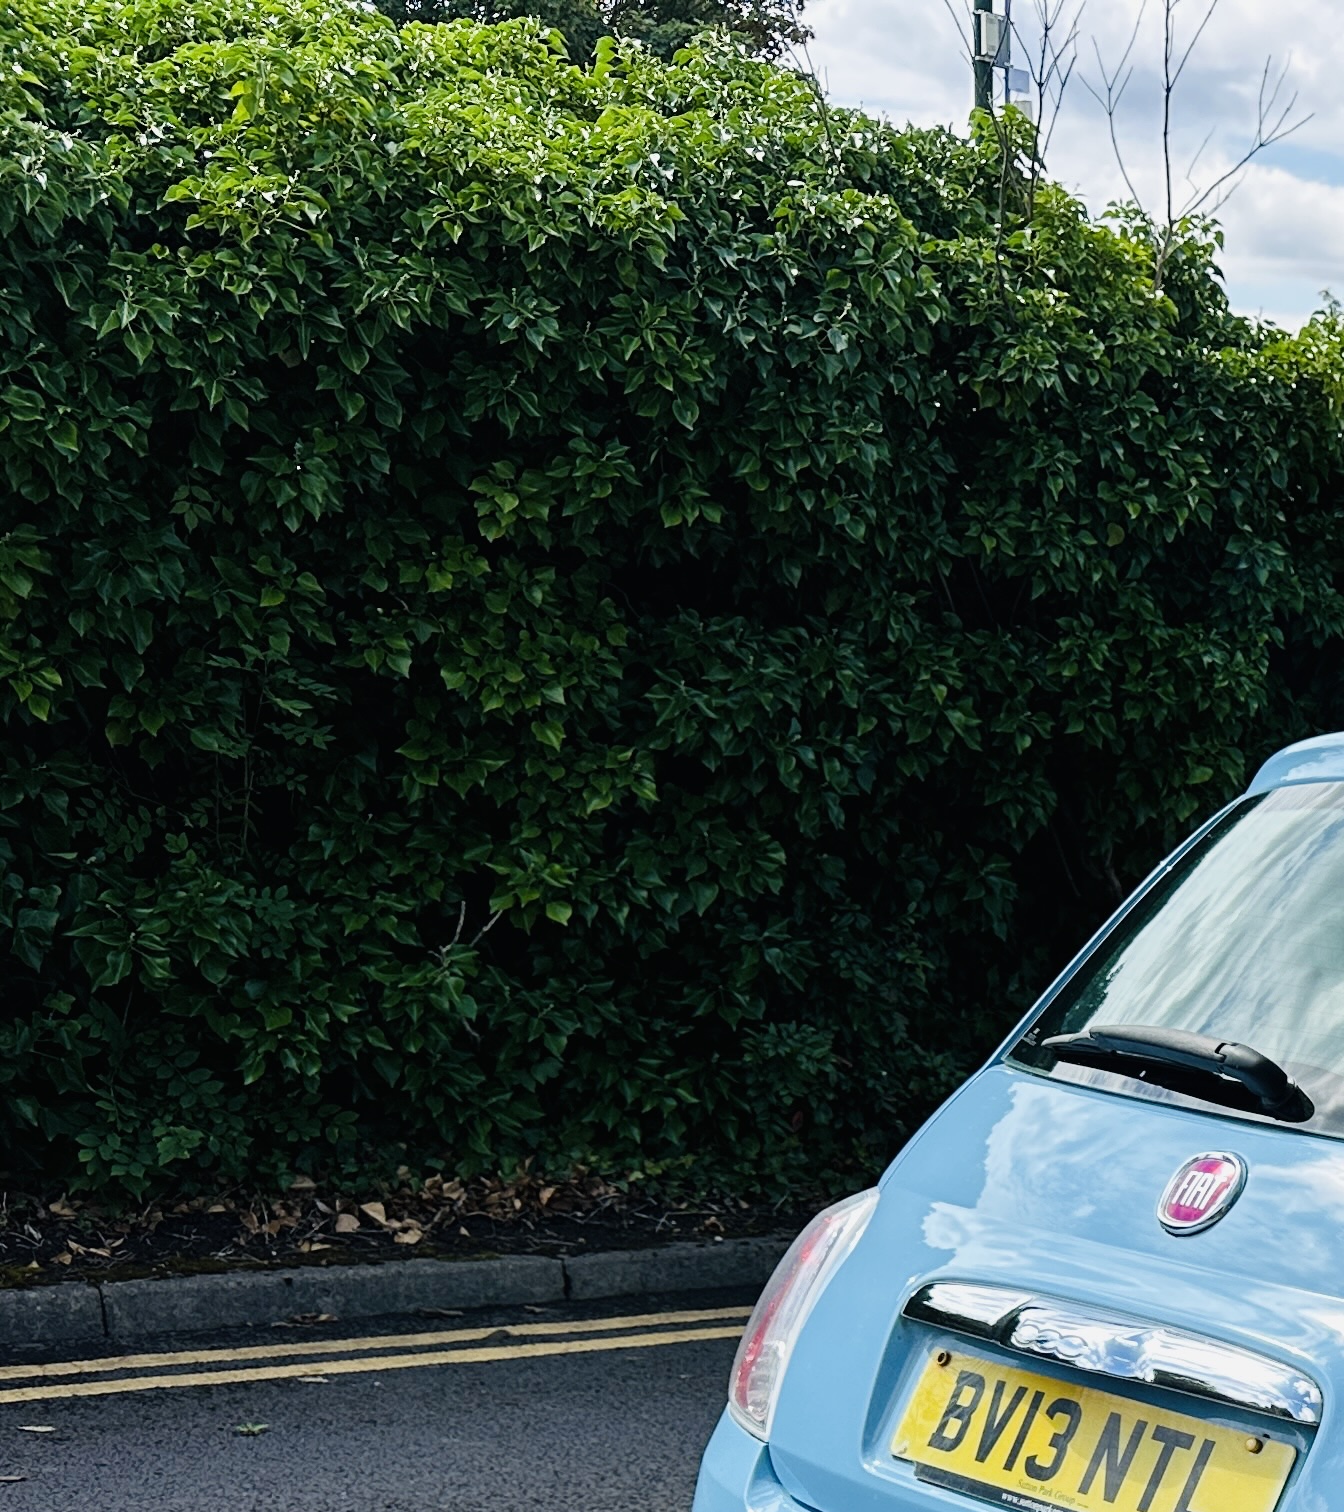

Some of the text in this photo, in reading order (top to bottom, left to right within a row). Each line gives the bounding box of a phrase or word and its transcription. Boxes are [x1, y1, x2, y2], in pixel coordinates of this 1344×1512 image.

[1171, 1170, 1228, 1211] FIAT
[927, 1370, 1082, 1482] BV13
[1017, 1479, 1038, 1492] Sutton
[1038, 1484, 1053, 1498] Park
[1054, 1489, 1076, 1506] Group
